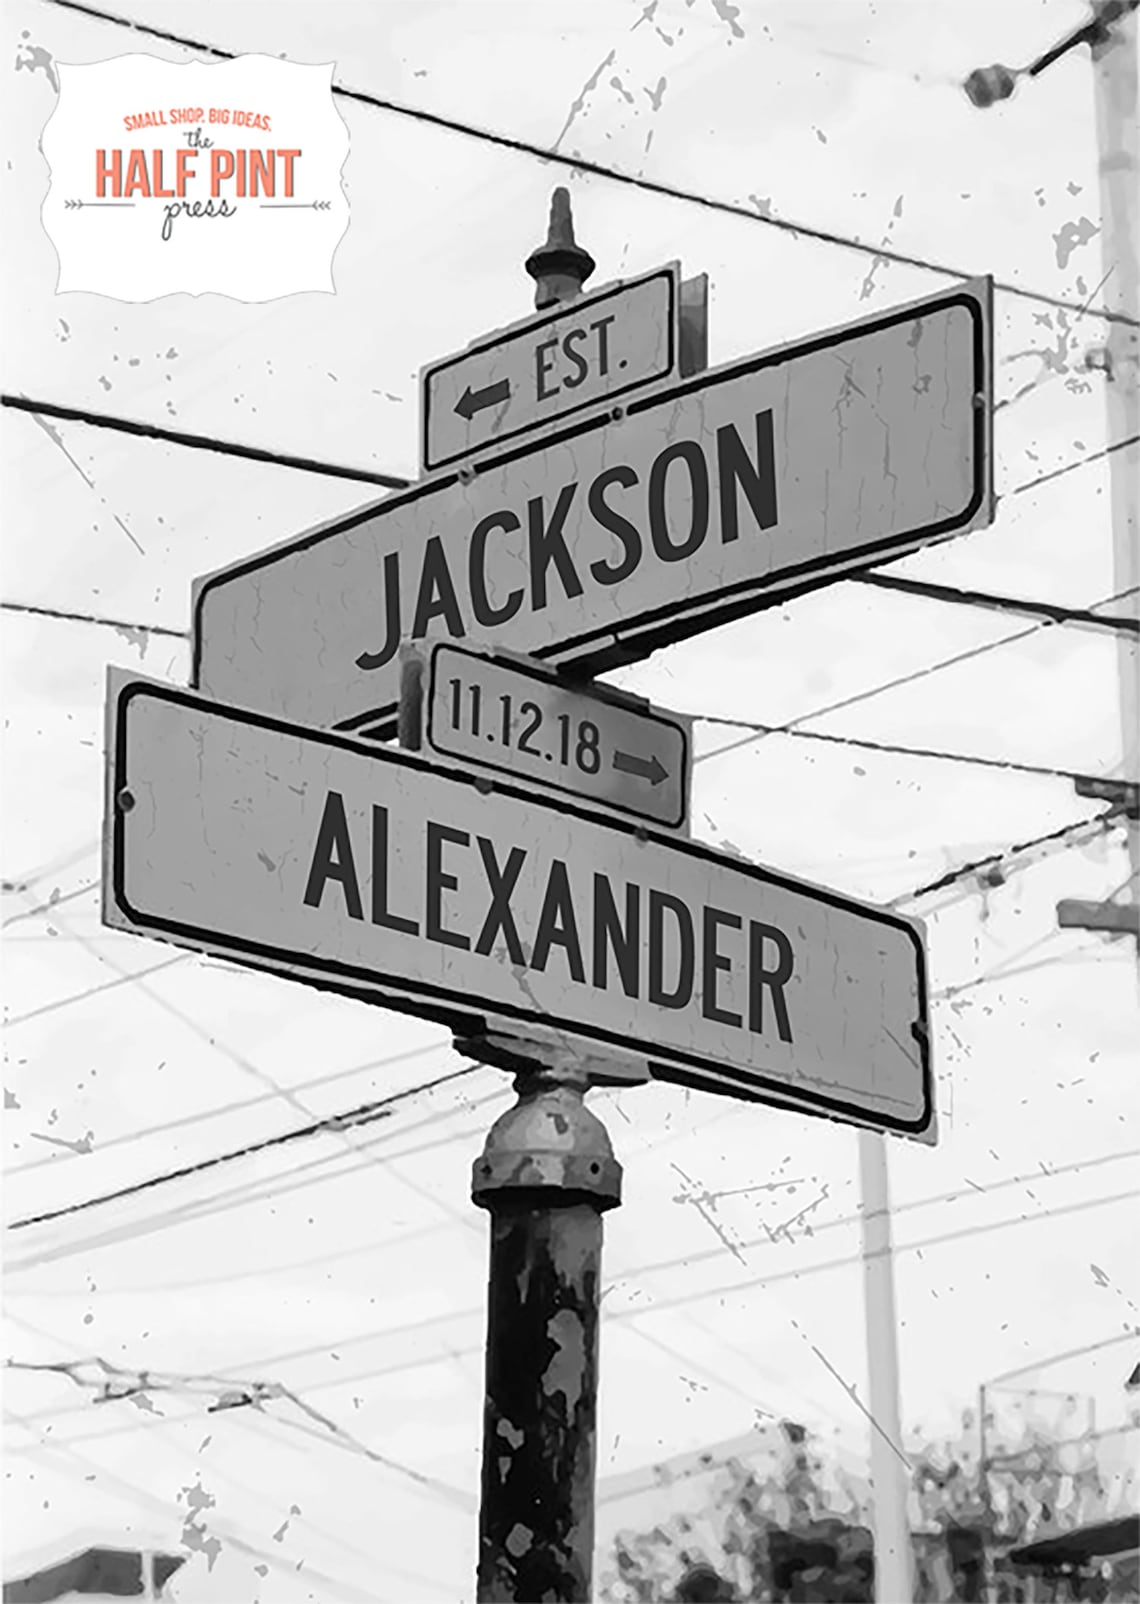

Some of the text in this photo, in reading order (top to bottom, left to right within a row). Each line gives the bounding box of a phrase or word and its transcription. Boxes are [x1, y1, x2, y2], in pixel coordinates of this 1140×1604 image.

[535, 315, 628, 402] EST.
[355, 408, 778, 671] JACKSON
[449, 679, 601, 775] 11.12.18
[303, 790, 795, 1044] ALEXANDER
